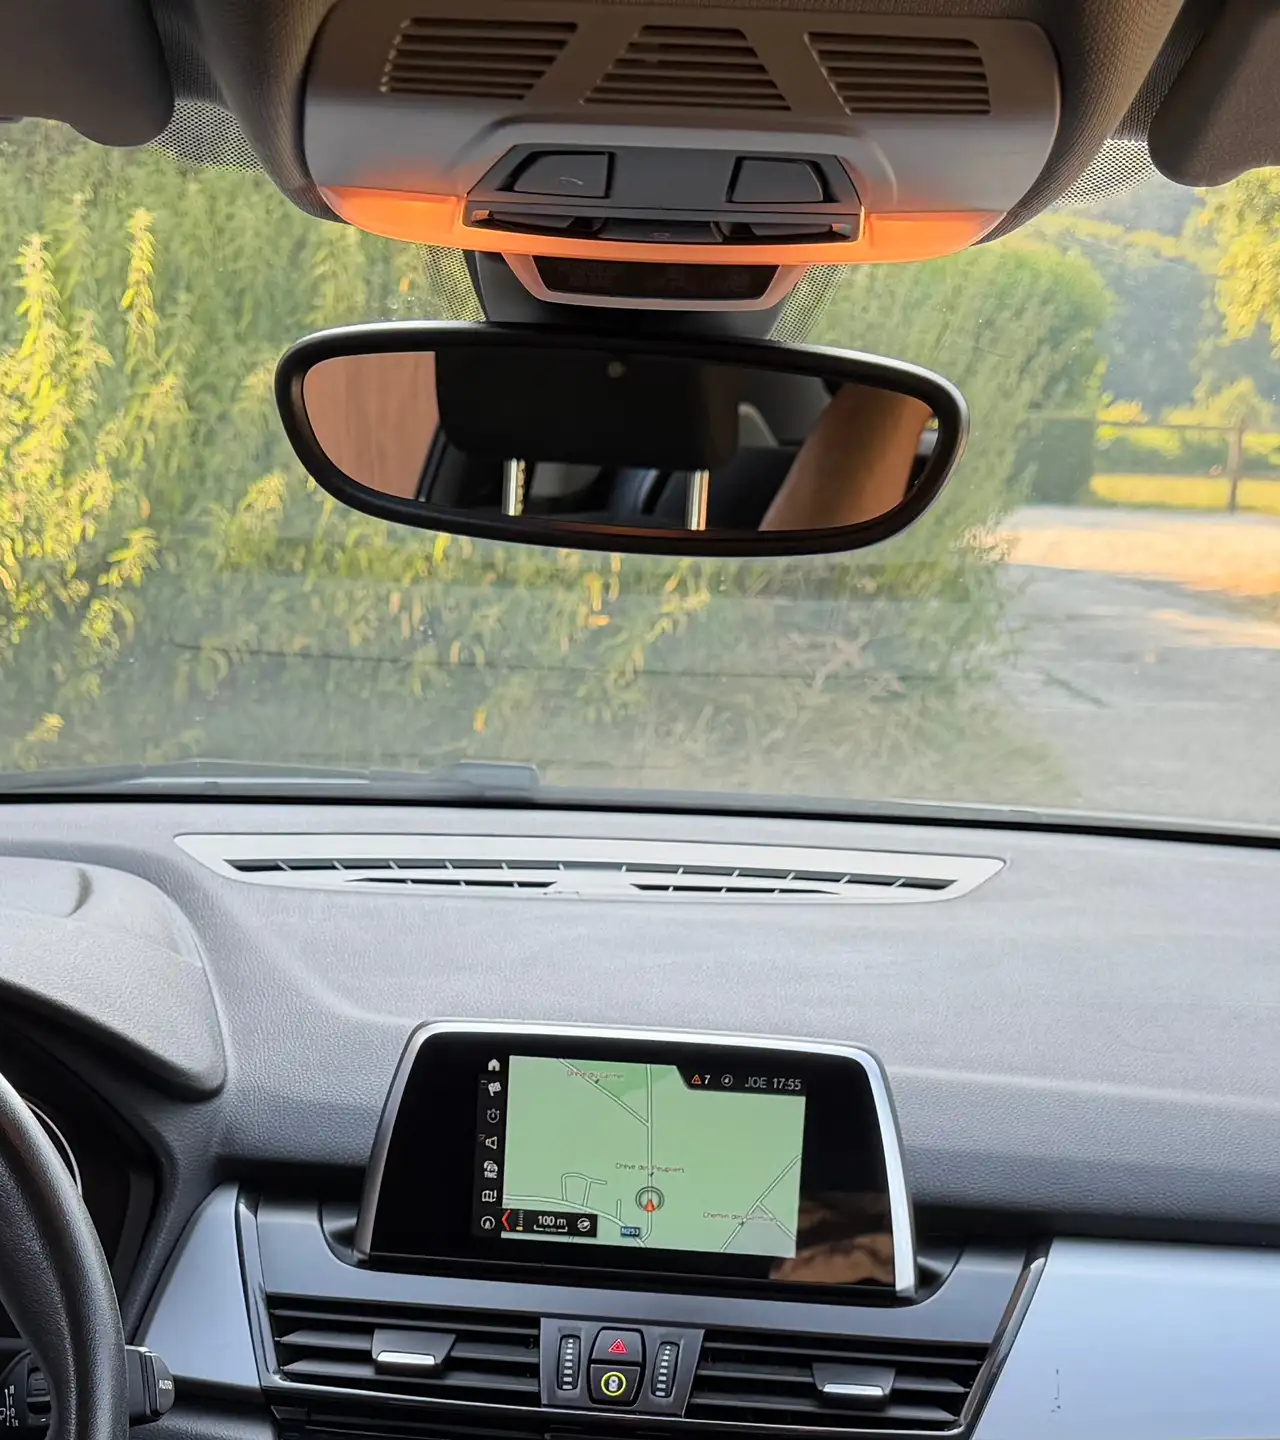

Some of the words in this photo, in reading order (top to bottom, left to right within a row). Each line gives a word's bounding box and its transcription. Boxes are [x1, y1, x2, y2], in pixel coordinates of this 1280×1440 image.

[704, 1074, 711, 1085] 7
[745, 1076, 768, 1088] JOE
[772, 1078, 802, 1090] 17:55
[537, 1215, 555, 1226] 100
[556, 1217, 567, 1227] m
